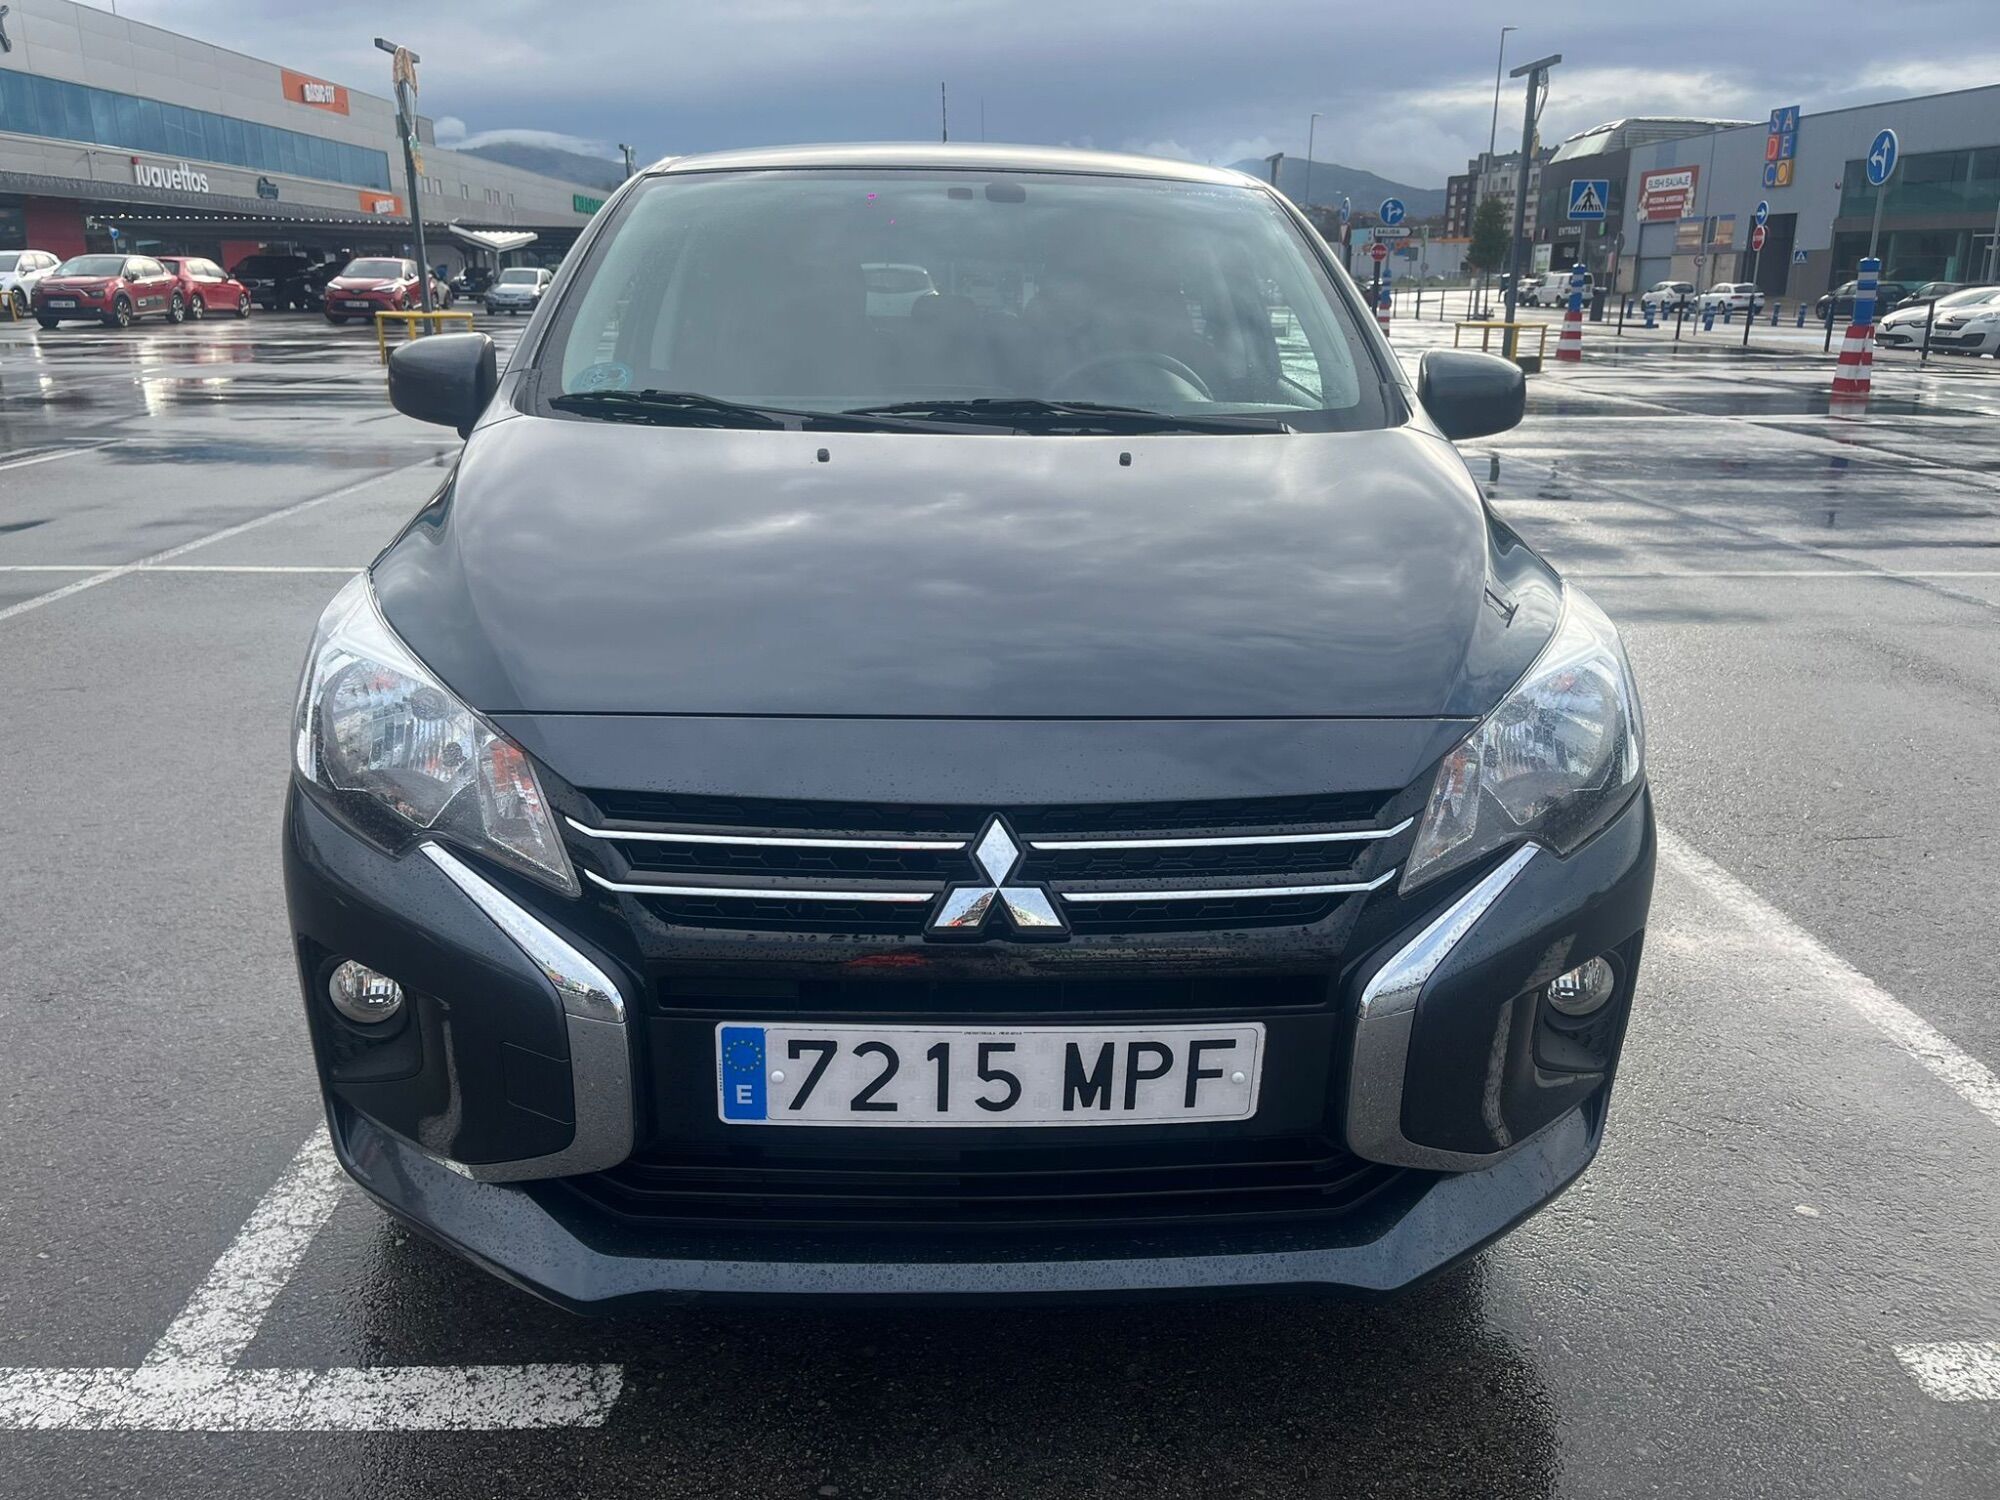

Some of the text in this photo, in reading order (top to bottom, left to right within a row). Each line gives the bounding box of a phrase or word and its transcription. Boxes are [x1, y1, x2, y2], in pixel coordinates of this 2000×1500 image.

[1772, 109, 1793, 132] SA
[1767, 136, 1790, 160] DE
[1765, 163, 1787, 185] CO
[787, 1039, 1022, 1112] 7215
[1062, 1038, 1237, 1112] MPF
[736, 1084, 752, 1104] E
